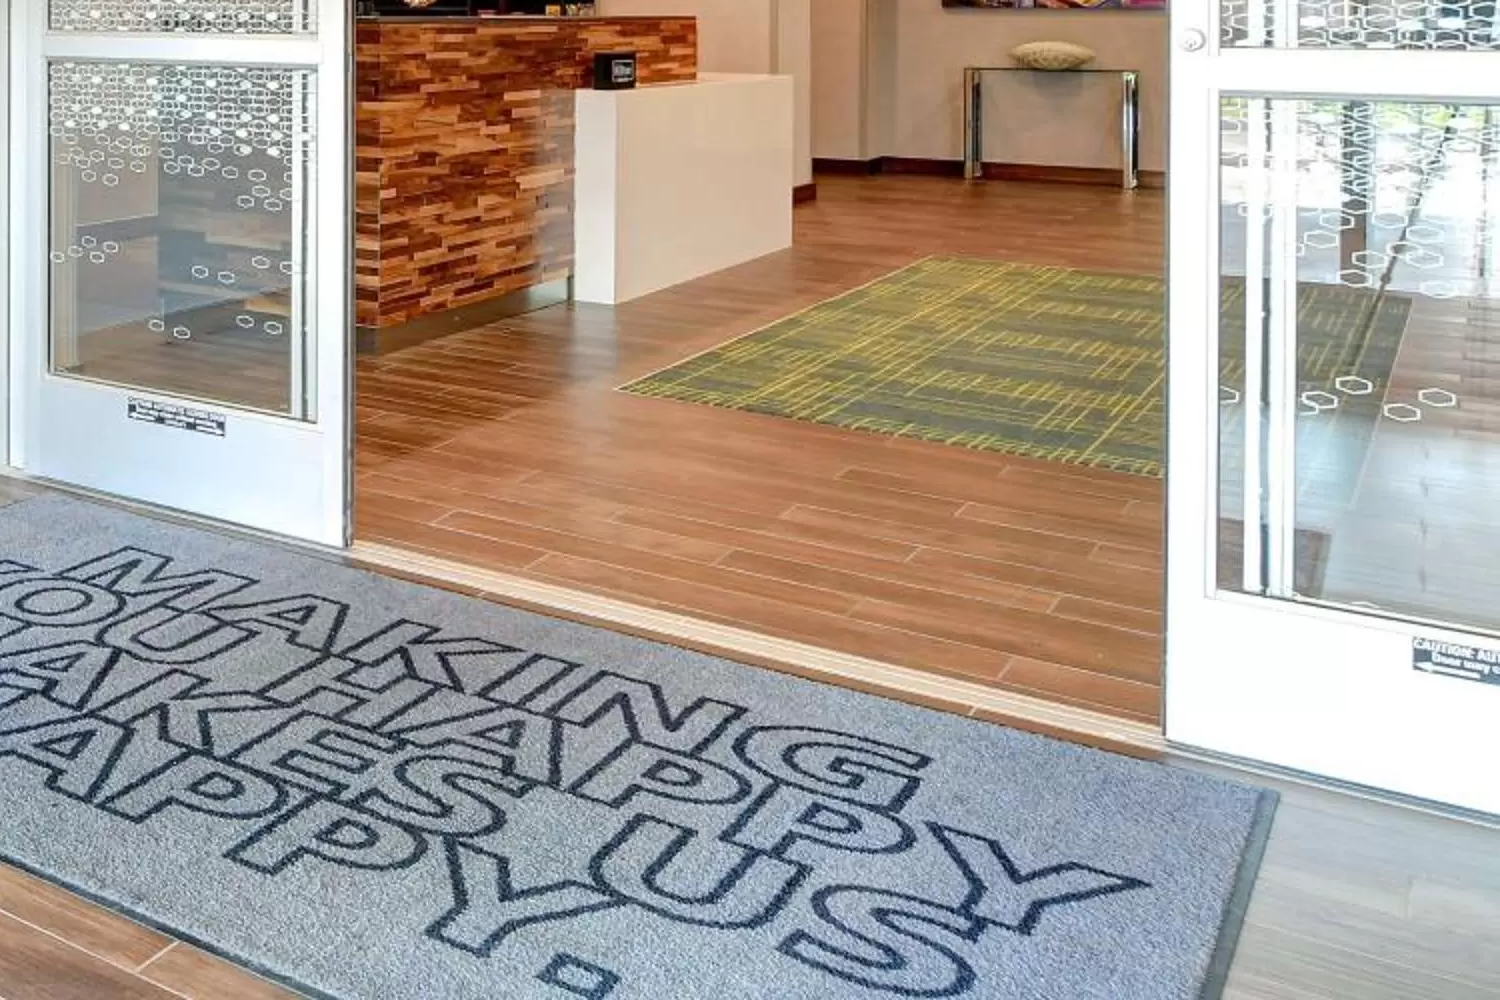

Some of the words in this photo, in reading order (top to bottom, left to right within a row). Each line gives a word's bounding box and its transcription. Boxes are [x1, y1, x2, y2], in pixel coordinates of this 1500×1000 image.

[52, 545, 933, 812] MAKING
[258, 653, 1153, 937] HAPPY
[588, 814, 987, 1000] US
